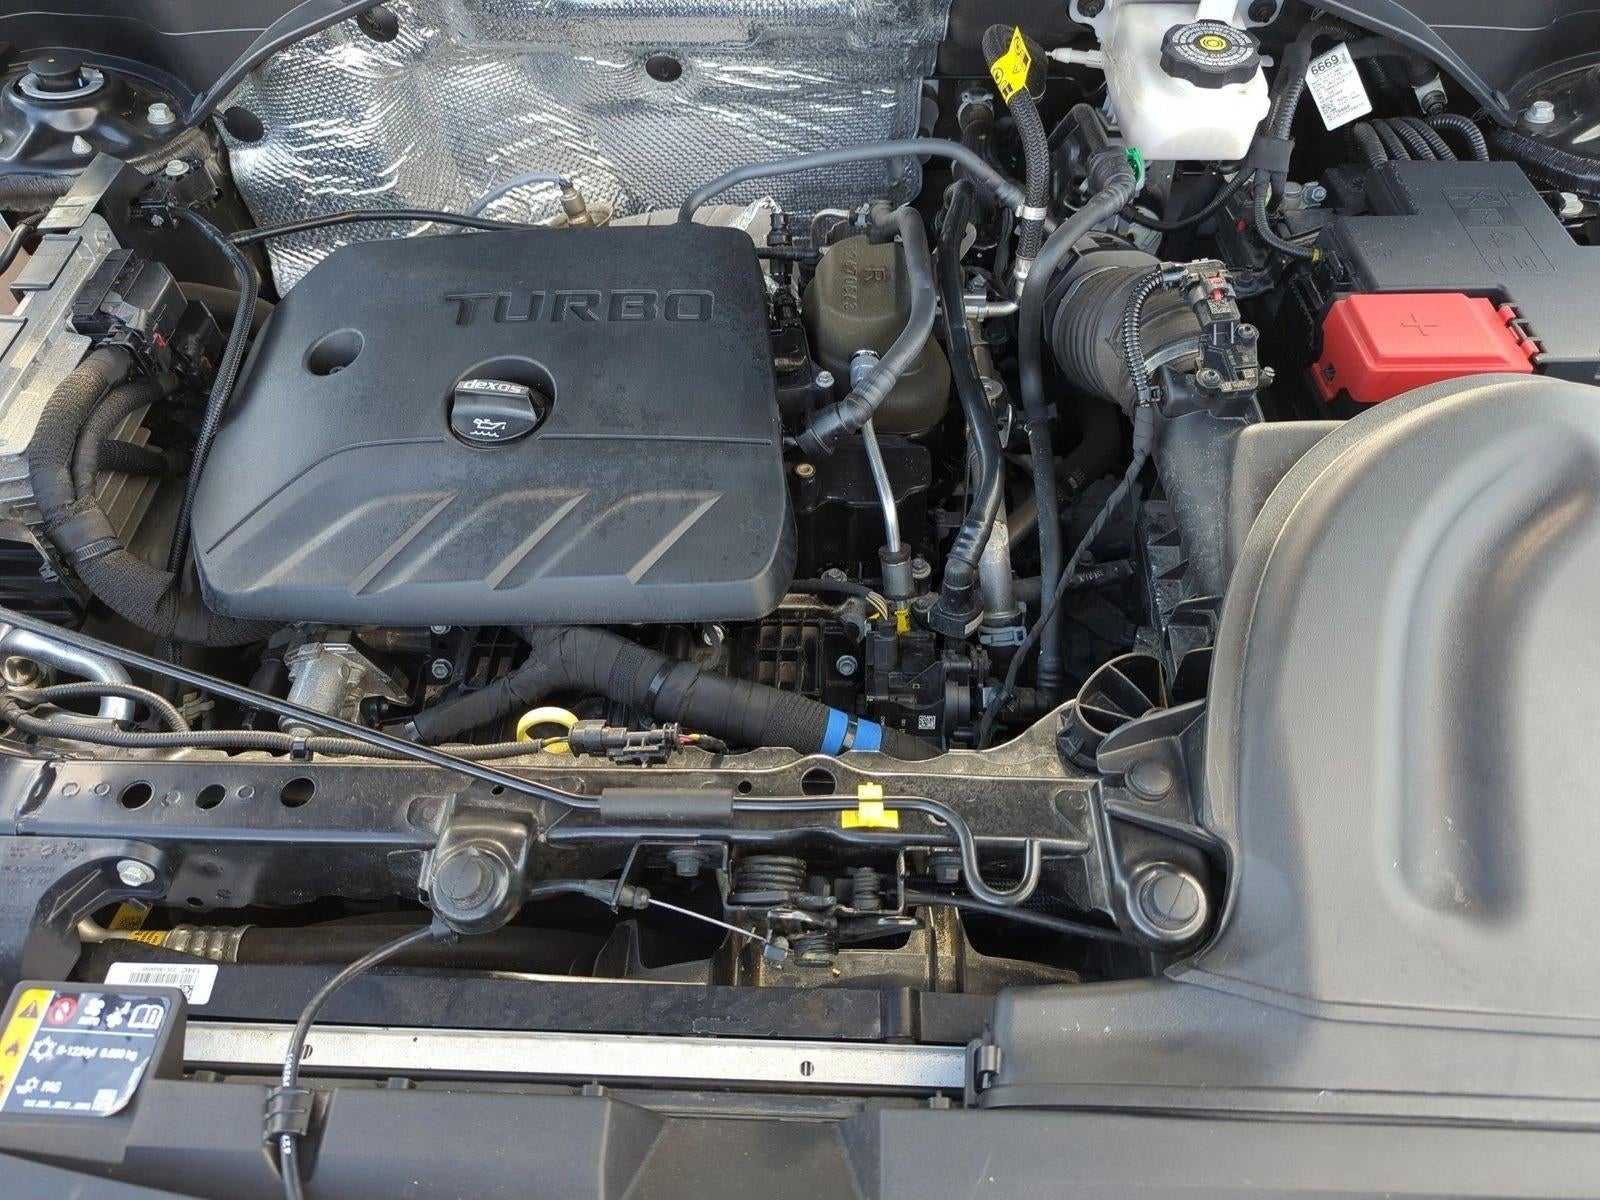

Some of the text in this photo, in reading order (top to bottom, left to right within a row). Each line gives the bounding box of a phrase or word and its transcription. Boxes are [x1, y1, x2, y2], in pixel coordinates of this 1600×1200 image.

[1311, 54, 1340, 75] 6669
[445, 289, 715, 325] TURBO
[463, 379, 524, 394] dexos
